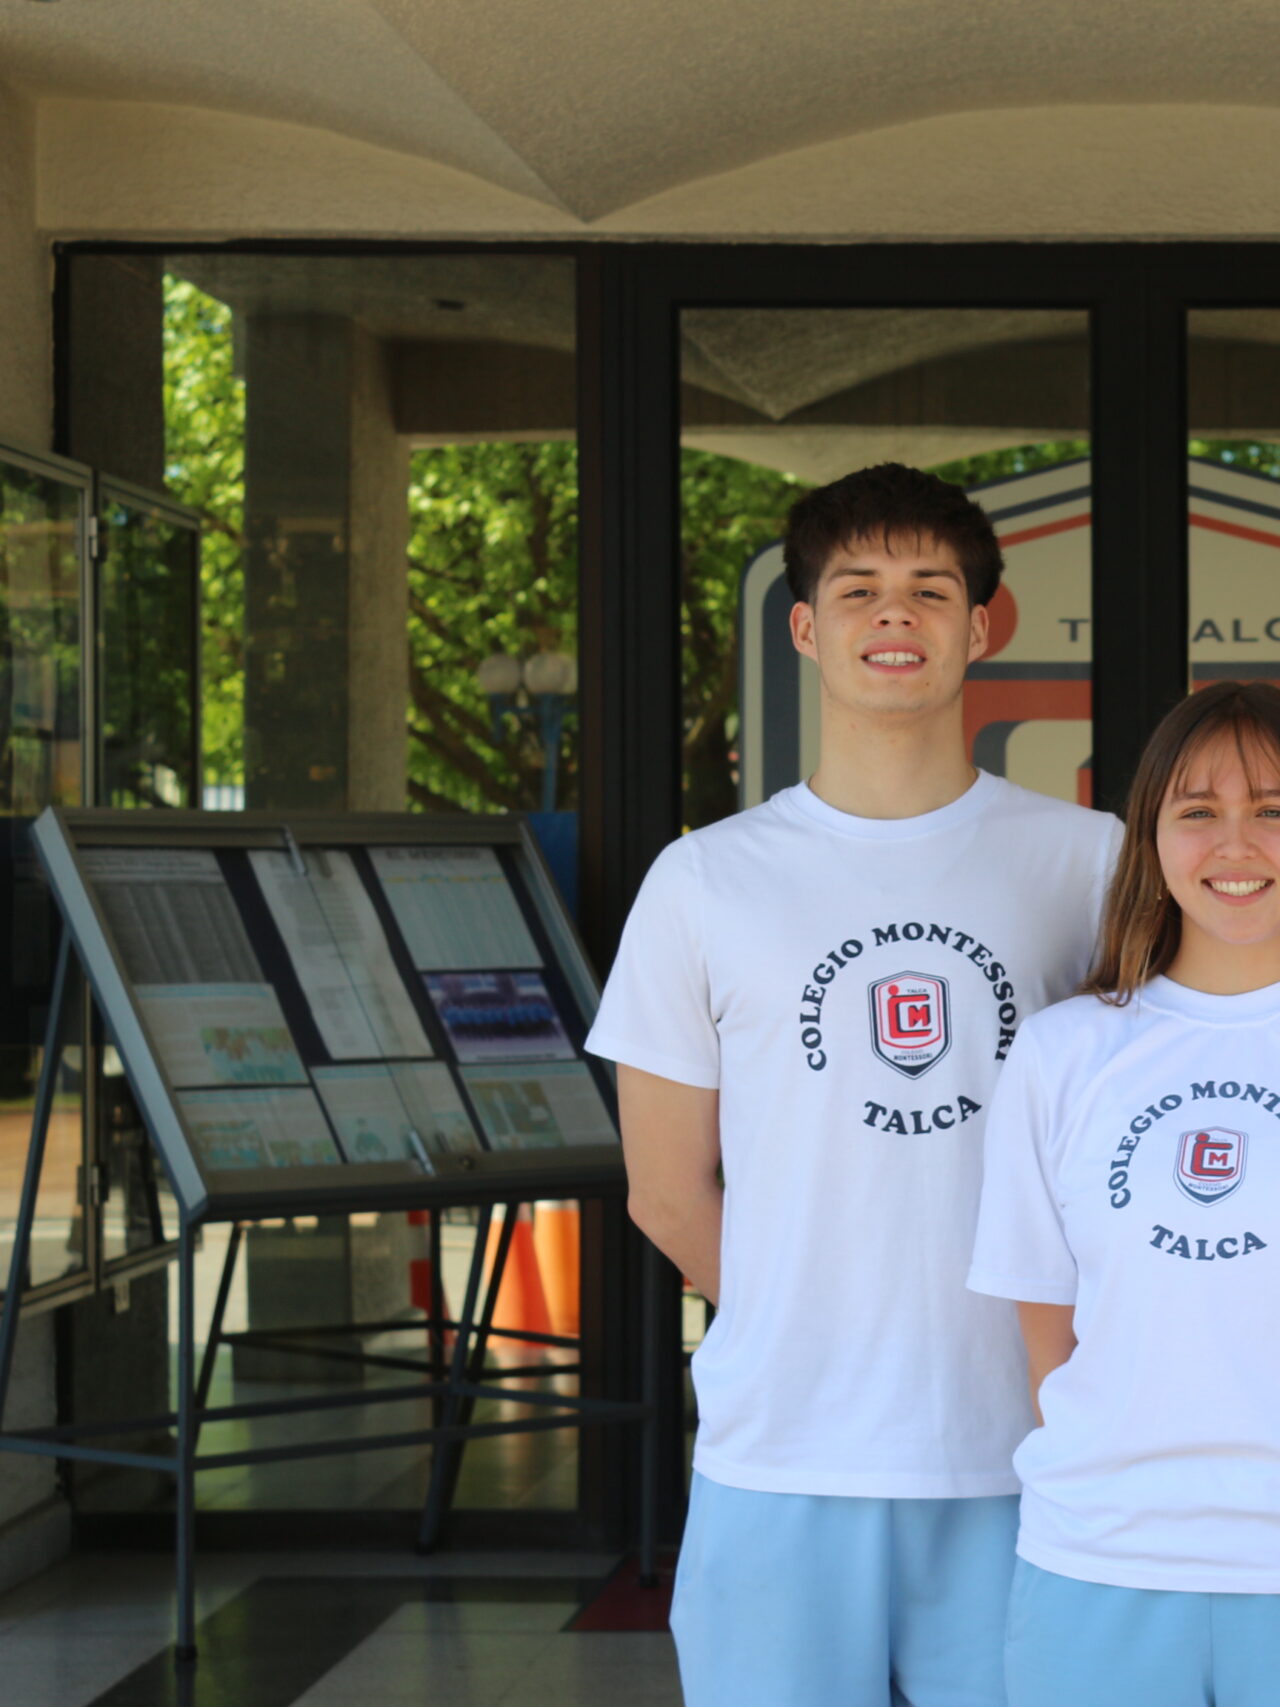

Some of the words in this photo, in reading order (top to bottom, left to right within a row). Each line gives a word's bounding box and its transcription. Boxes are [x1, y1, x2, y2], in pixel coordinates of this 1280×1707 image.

[800, 938, 863, 1071] COLEGIO
[863, 1095, 982, 1135] TALCA
[1108, 1094, 1183, 1209] COLEGIO
[1149, 1224, 1268, 1261] TALCA
